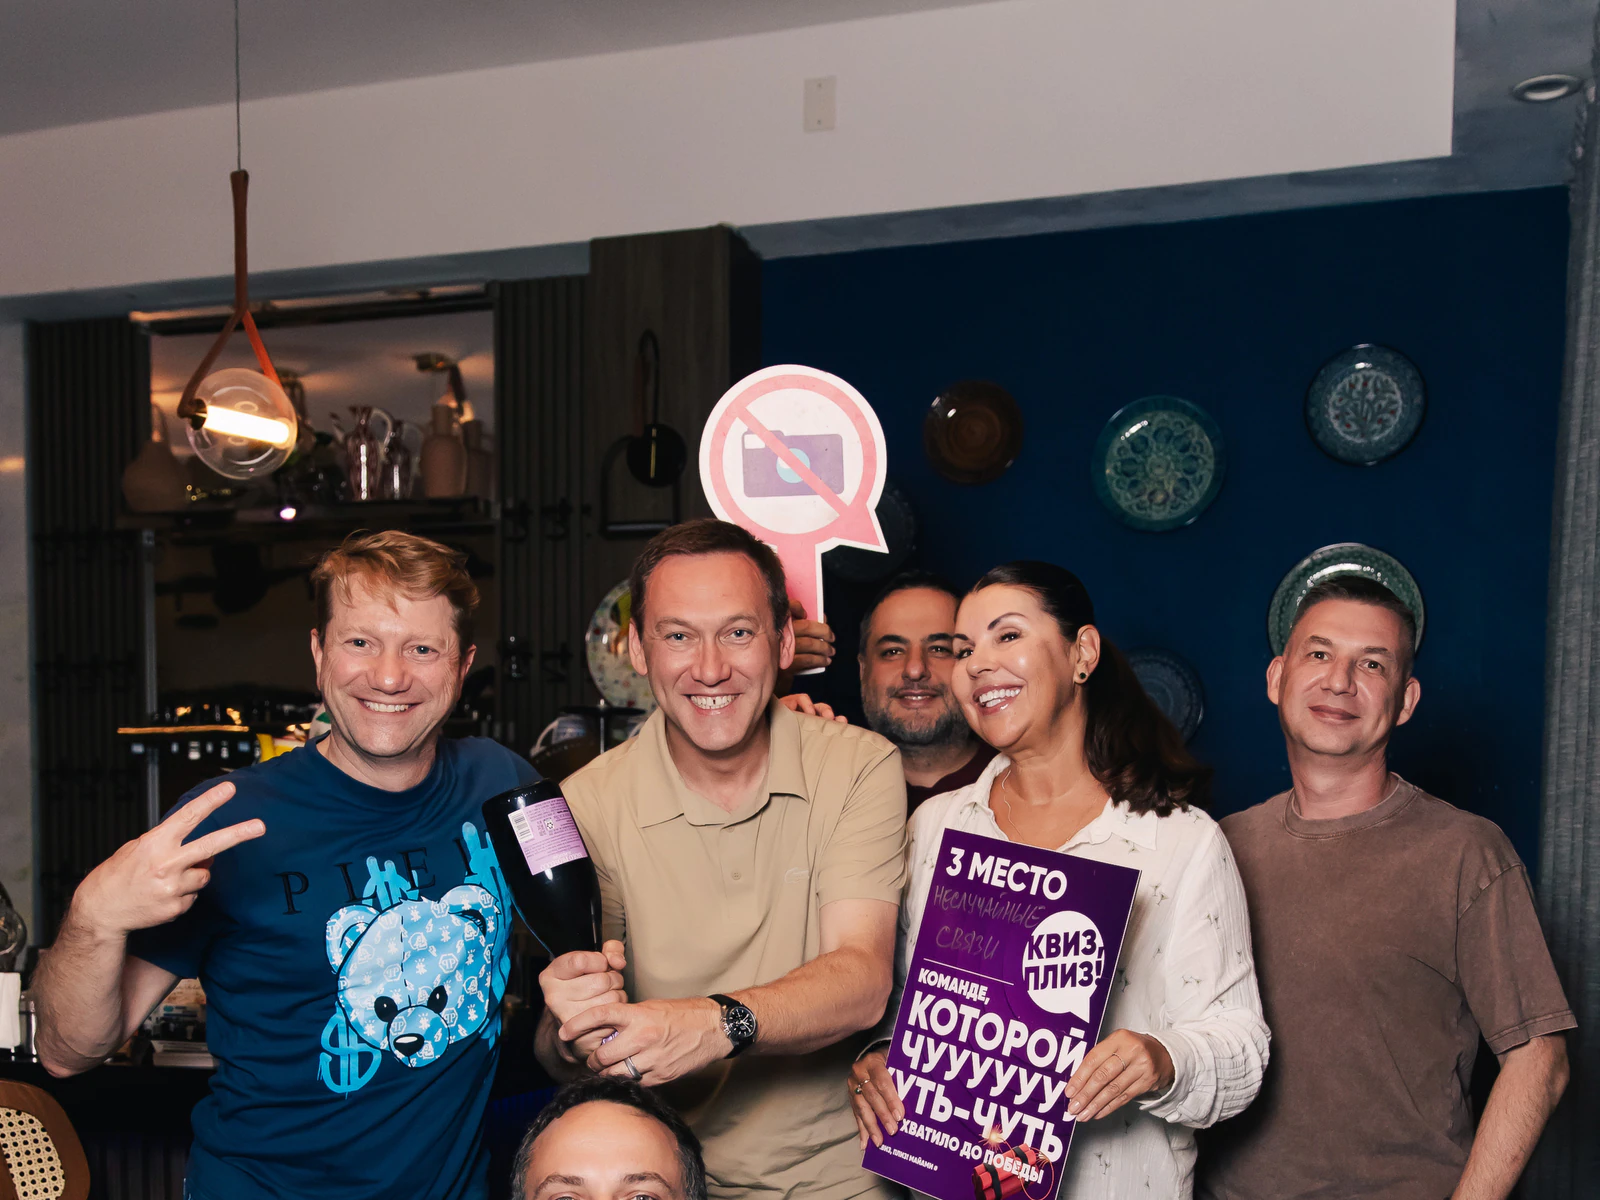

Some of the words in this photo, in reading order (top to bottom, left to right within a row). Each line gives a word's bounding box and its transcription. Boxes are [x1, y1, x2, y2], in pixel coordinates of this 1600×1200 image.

[275, 829, 491, 915] PLEI
[946, 847, 965, 877] 3
[967, 852, 1068, 901] МЕСТО
[933, 885, 1046, 929] НЕСЛУЧАЙНЫЕ
[936, 925, 1000, 959] СВЯЗИ
[1027, 929, 1105, 960] КВИЗ,
[918, 968, 990, 1005] КОМАНДЕ,
[1024, 960, 1105, 991] ПЛИЗ!
[907, 990, 1088, 1077] КОТОРОЙ
[901, 1029, 1078, 1123] ЧУУУУУУ
[886, 1066, 1064, 1163] УТЬ-ЧУТЬ
[879, 1144, 893, 1155] ВИЗ,
[900, 1118, 960, 1151] ХВАТИЛО
[960, 1141, 984, 1161] ДО
[983, 1150, 1045, 1184] ПОБЕДЫ
